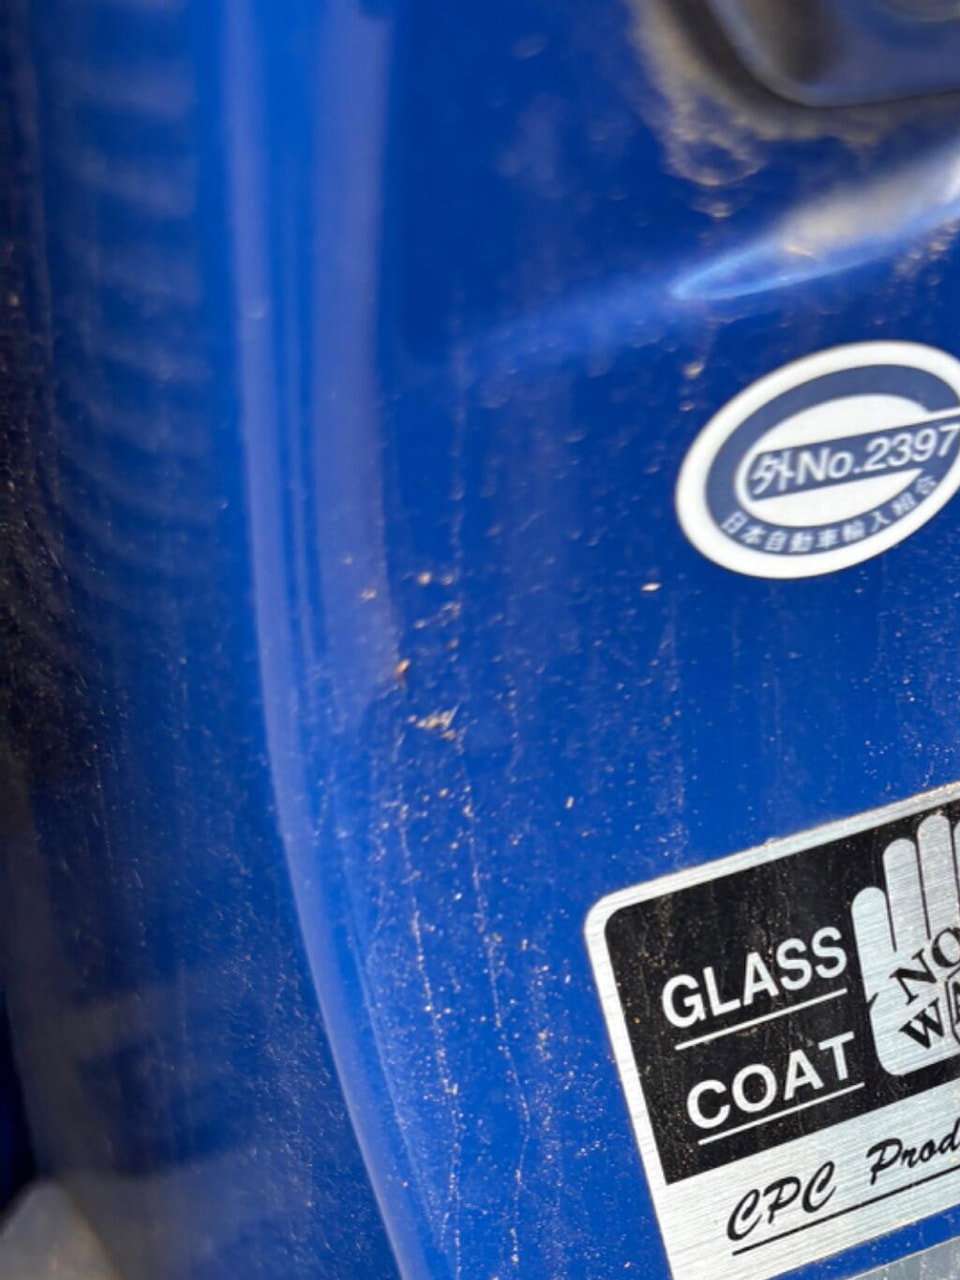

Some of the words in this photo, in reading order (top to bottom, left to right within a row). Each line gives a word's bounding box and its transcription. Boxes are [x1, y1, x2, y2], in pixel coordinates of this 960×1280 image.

[661, 925, 848, 1029] GLASS
[686, 1031, 856, 1129] COAT
[726, 1160, 836, 1241] CPC
